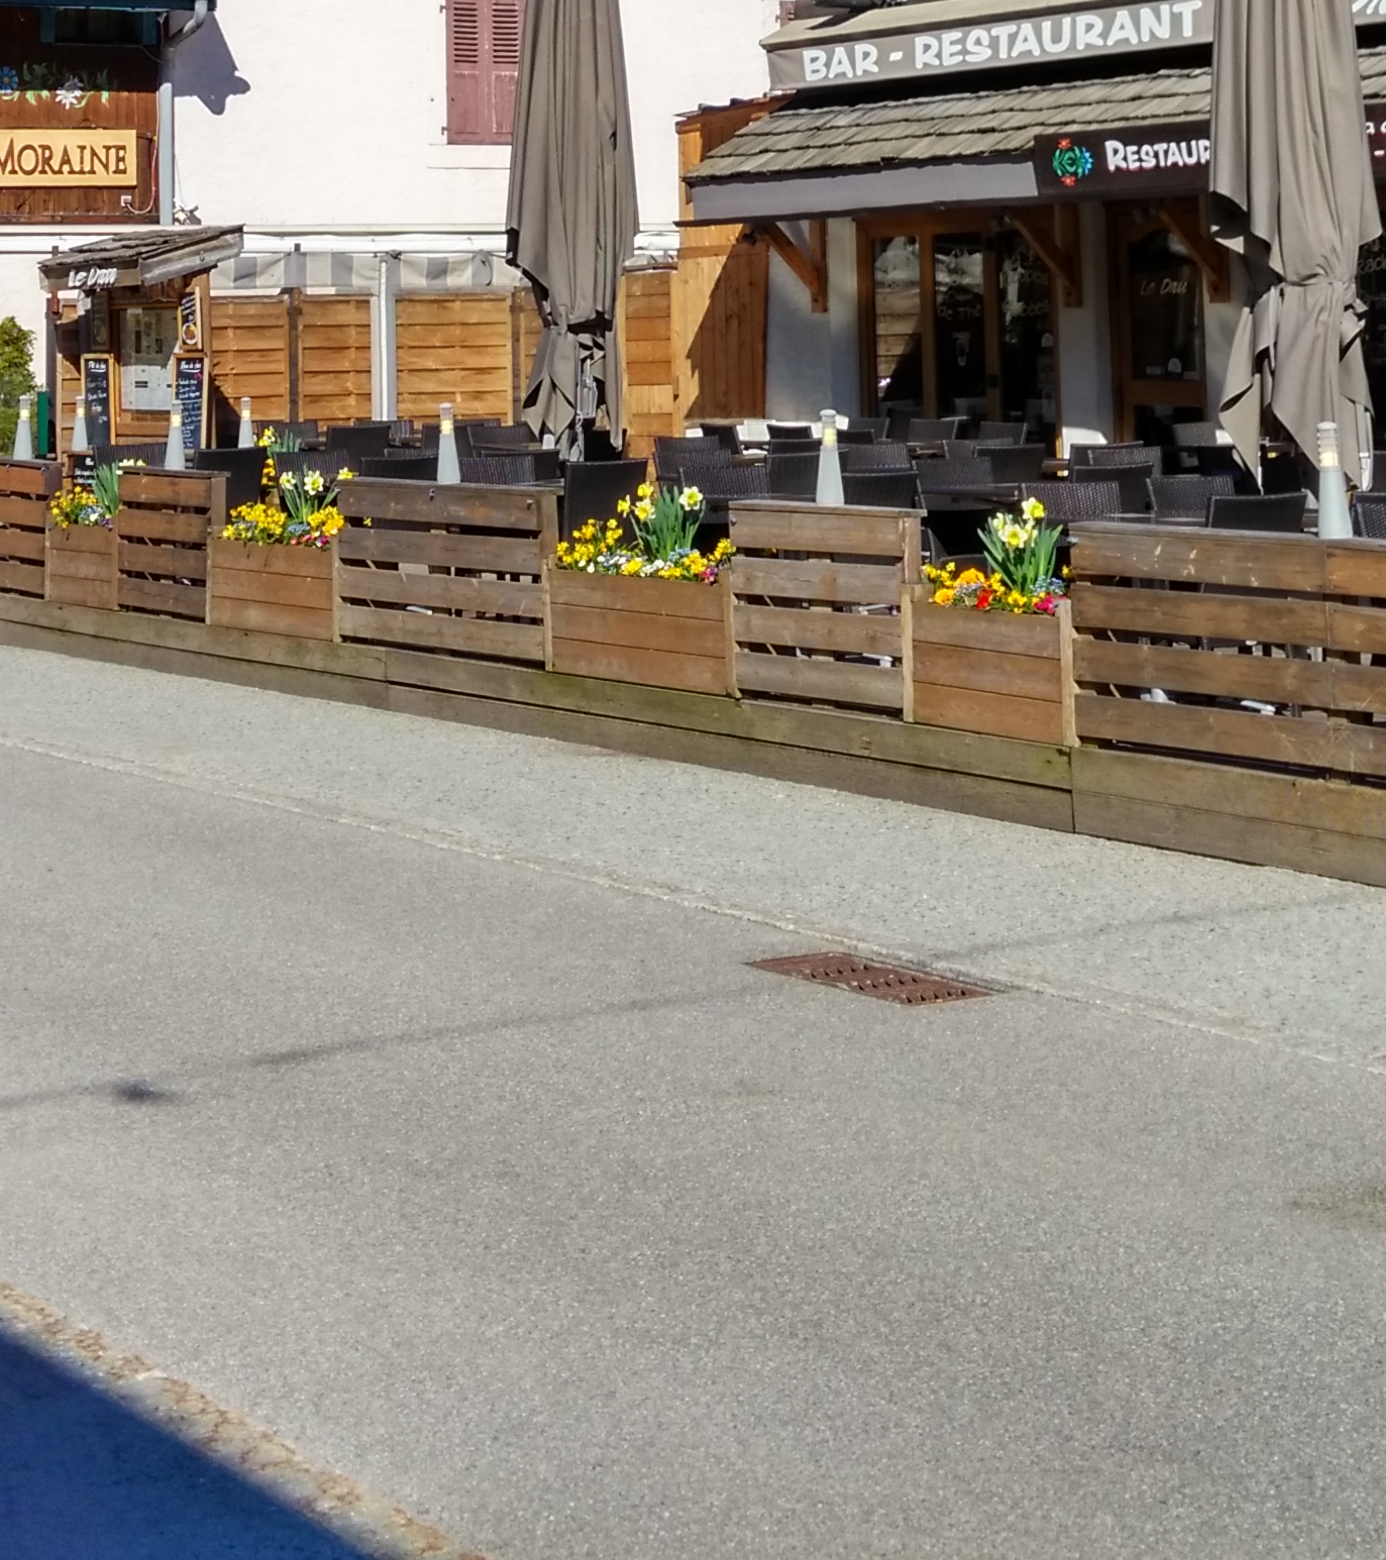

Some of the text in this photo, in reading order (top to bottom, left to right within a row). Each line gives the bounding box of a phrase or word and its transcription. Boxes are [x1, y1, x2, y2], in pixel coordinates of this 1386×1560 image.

[803, 44, 879, 82] BAR
[914, 0, 1203, 69] RESTAURANT
[1104, 139, 1210, 173] RESTAUR
[68, 268, 87, 287] Le
[1140, 279, 1156, 296] Le
